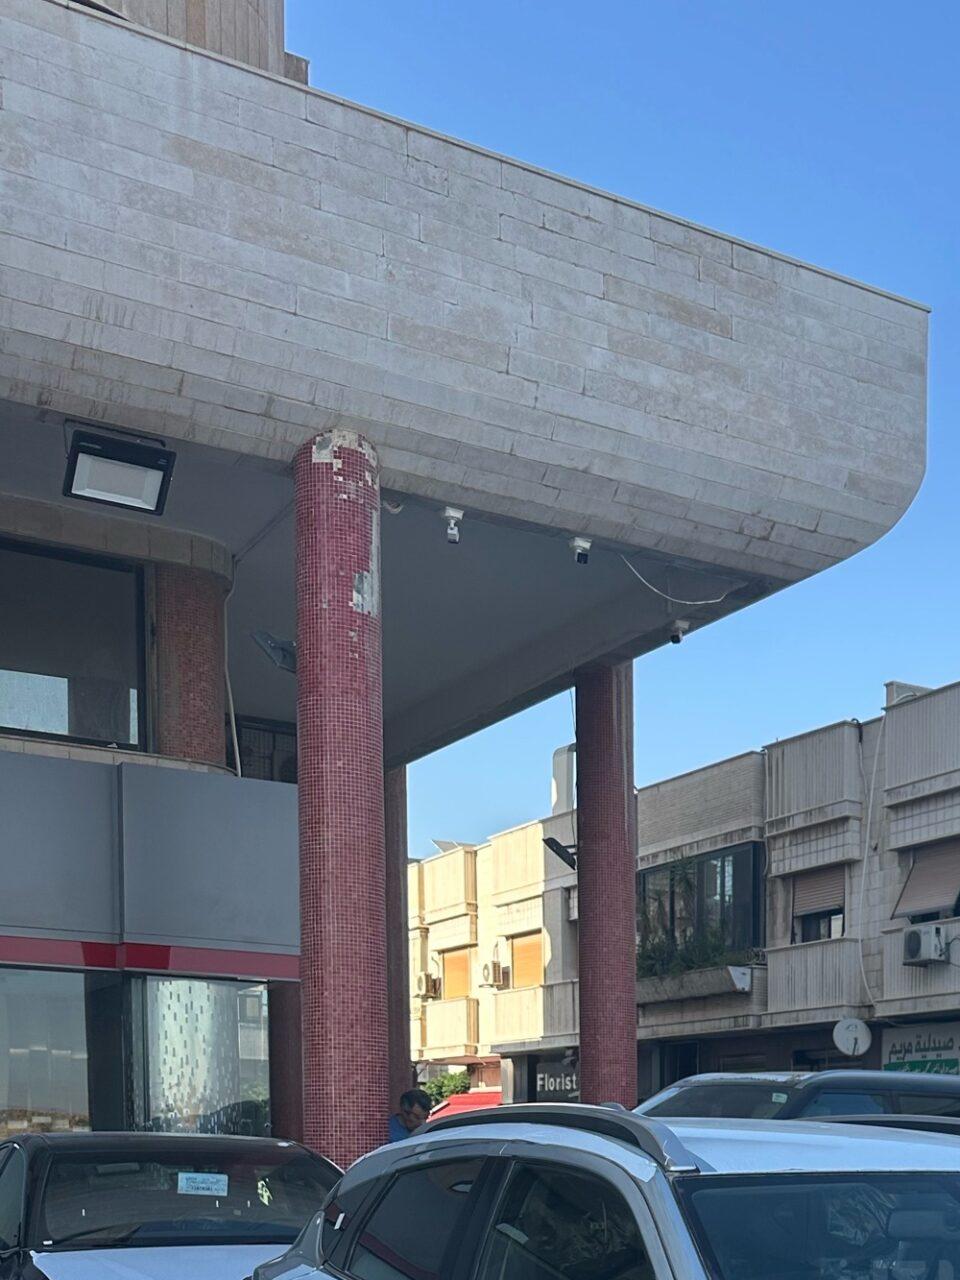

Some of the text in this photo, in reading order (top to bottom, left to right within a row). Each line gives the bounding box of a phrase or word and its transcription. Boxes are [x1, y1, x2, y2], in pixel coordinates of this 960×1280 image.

[888, 1032, 954, 1063] صيدلية مريم
[536, 1072, 577, 1092] Florist
